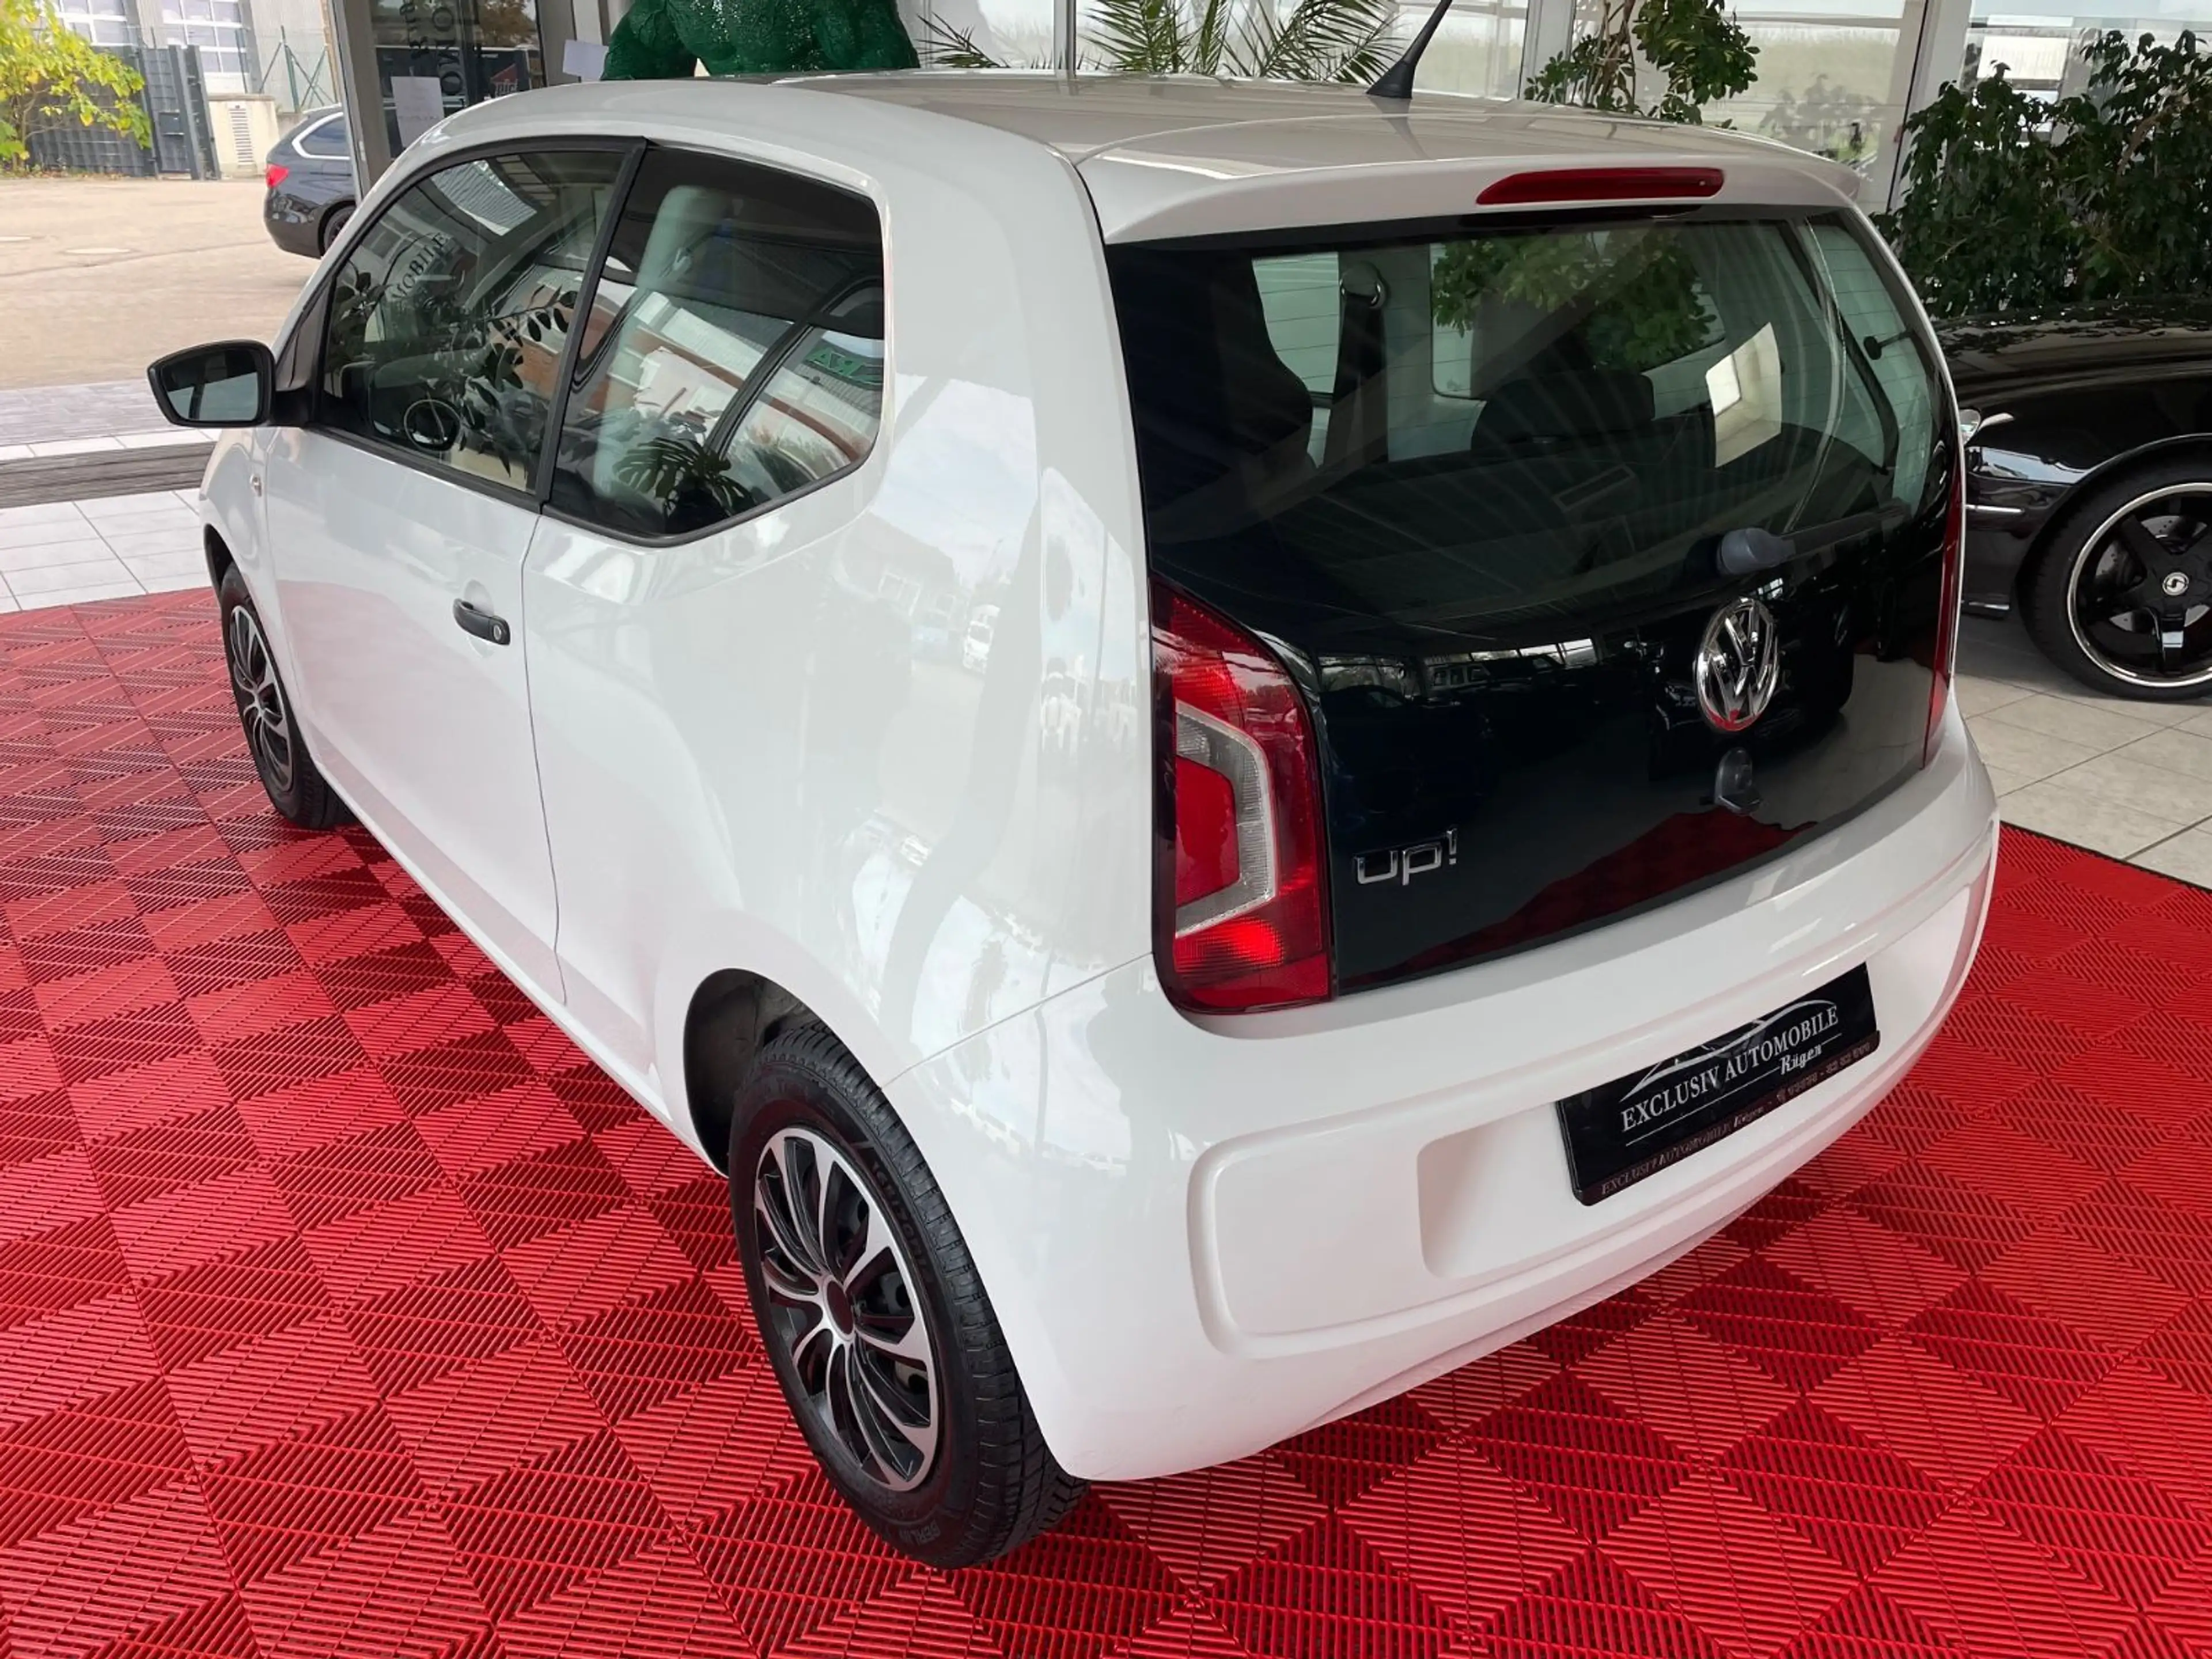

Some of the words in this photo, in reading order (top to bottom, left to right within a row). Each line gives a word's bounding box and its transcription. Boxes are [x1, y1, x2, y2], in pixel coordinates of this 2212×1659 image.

[1695, 599, 1778, 729] VW
[1355, 828, 1457, 885] up!
[1621, 1067, 1719, 1133] EXCLUSIV
[1725, 1006, 1839, 1082] AUTOMOBILE
[1779, 1043, 1823, 1075] Rügen
